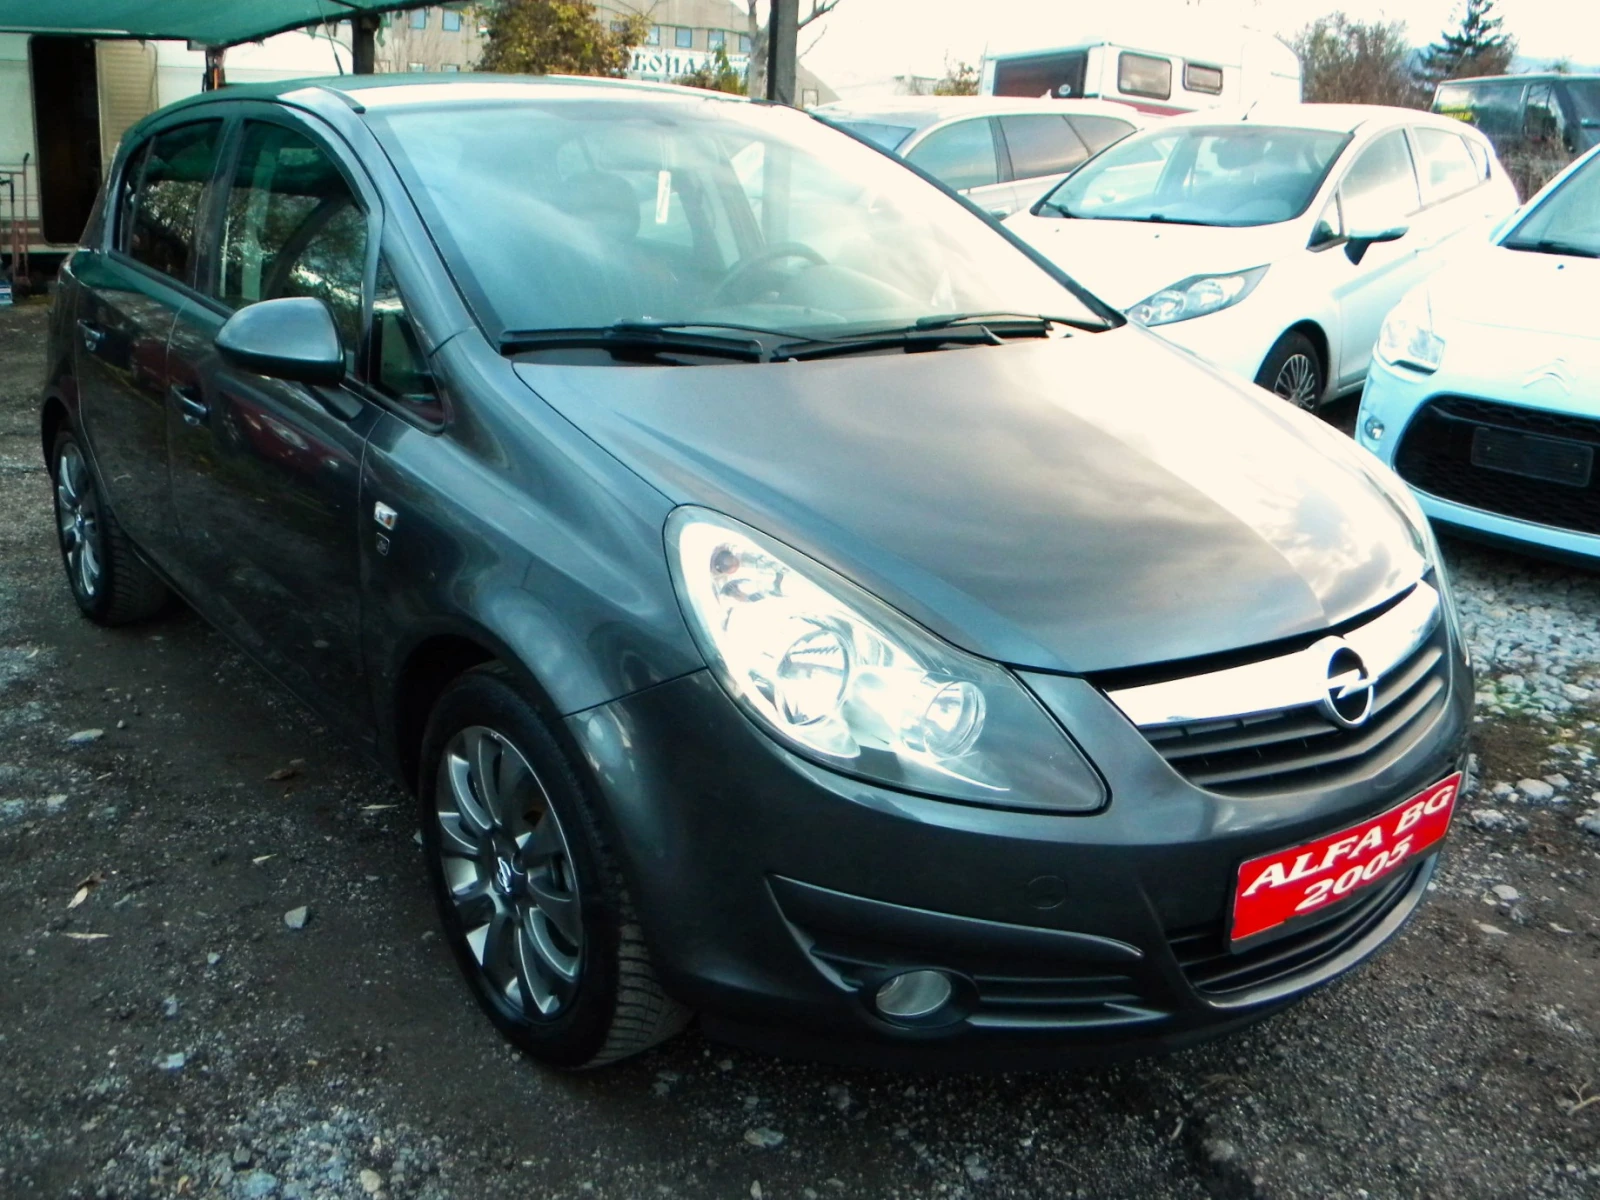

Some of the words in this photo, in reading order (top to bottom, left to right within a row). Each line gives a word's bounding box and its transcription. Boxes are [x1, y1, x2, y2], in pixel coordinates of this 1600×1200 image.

[1241, 825, 1383, 897] ALFA
[1392, 784, 1455, 836] BG
[1294, 834, 1414, 911] 2005
